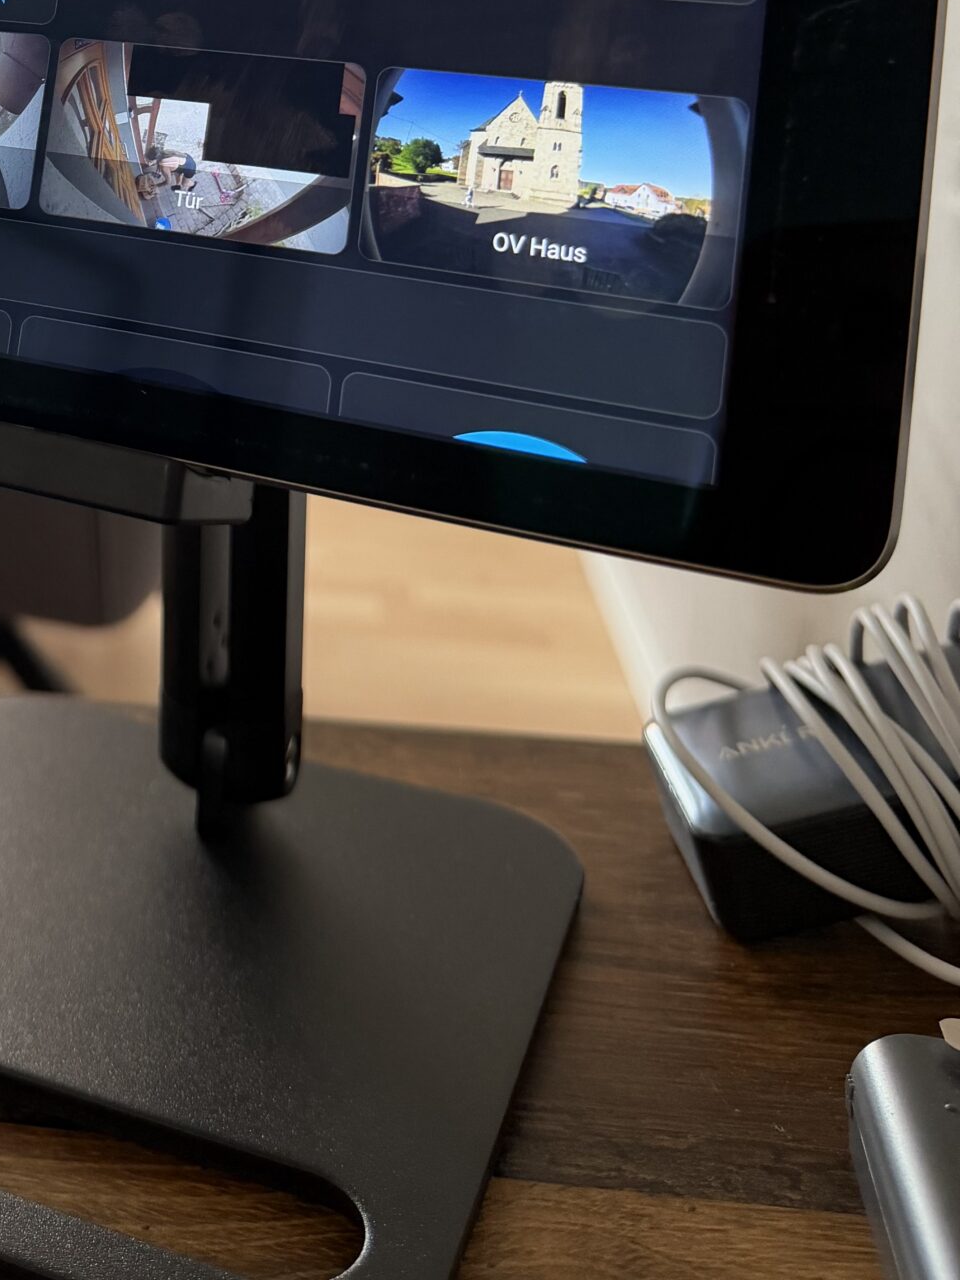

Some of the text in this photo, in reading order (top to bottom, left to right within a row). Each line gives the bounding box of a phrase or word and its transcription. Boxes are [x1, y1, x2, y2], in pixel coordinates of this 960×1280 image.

[174, 189, 204, 211] Tür
[492, 232, 588, 264] OV Haus
